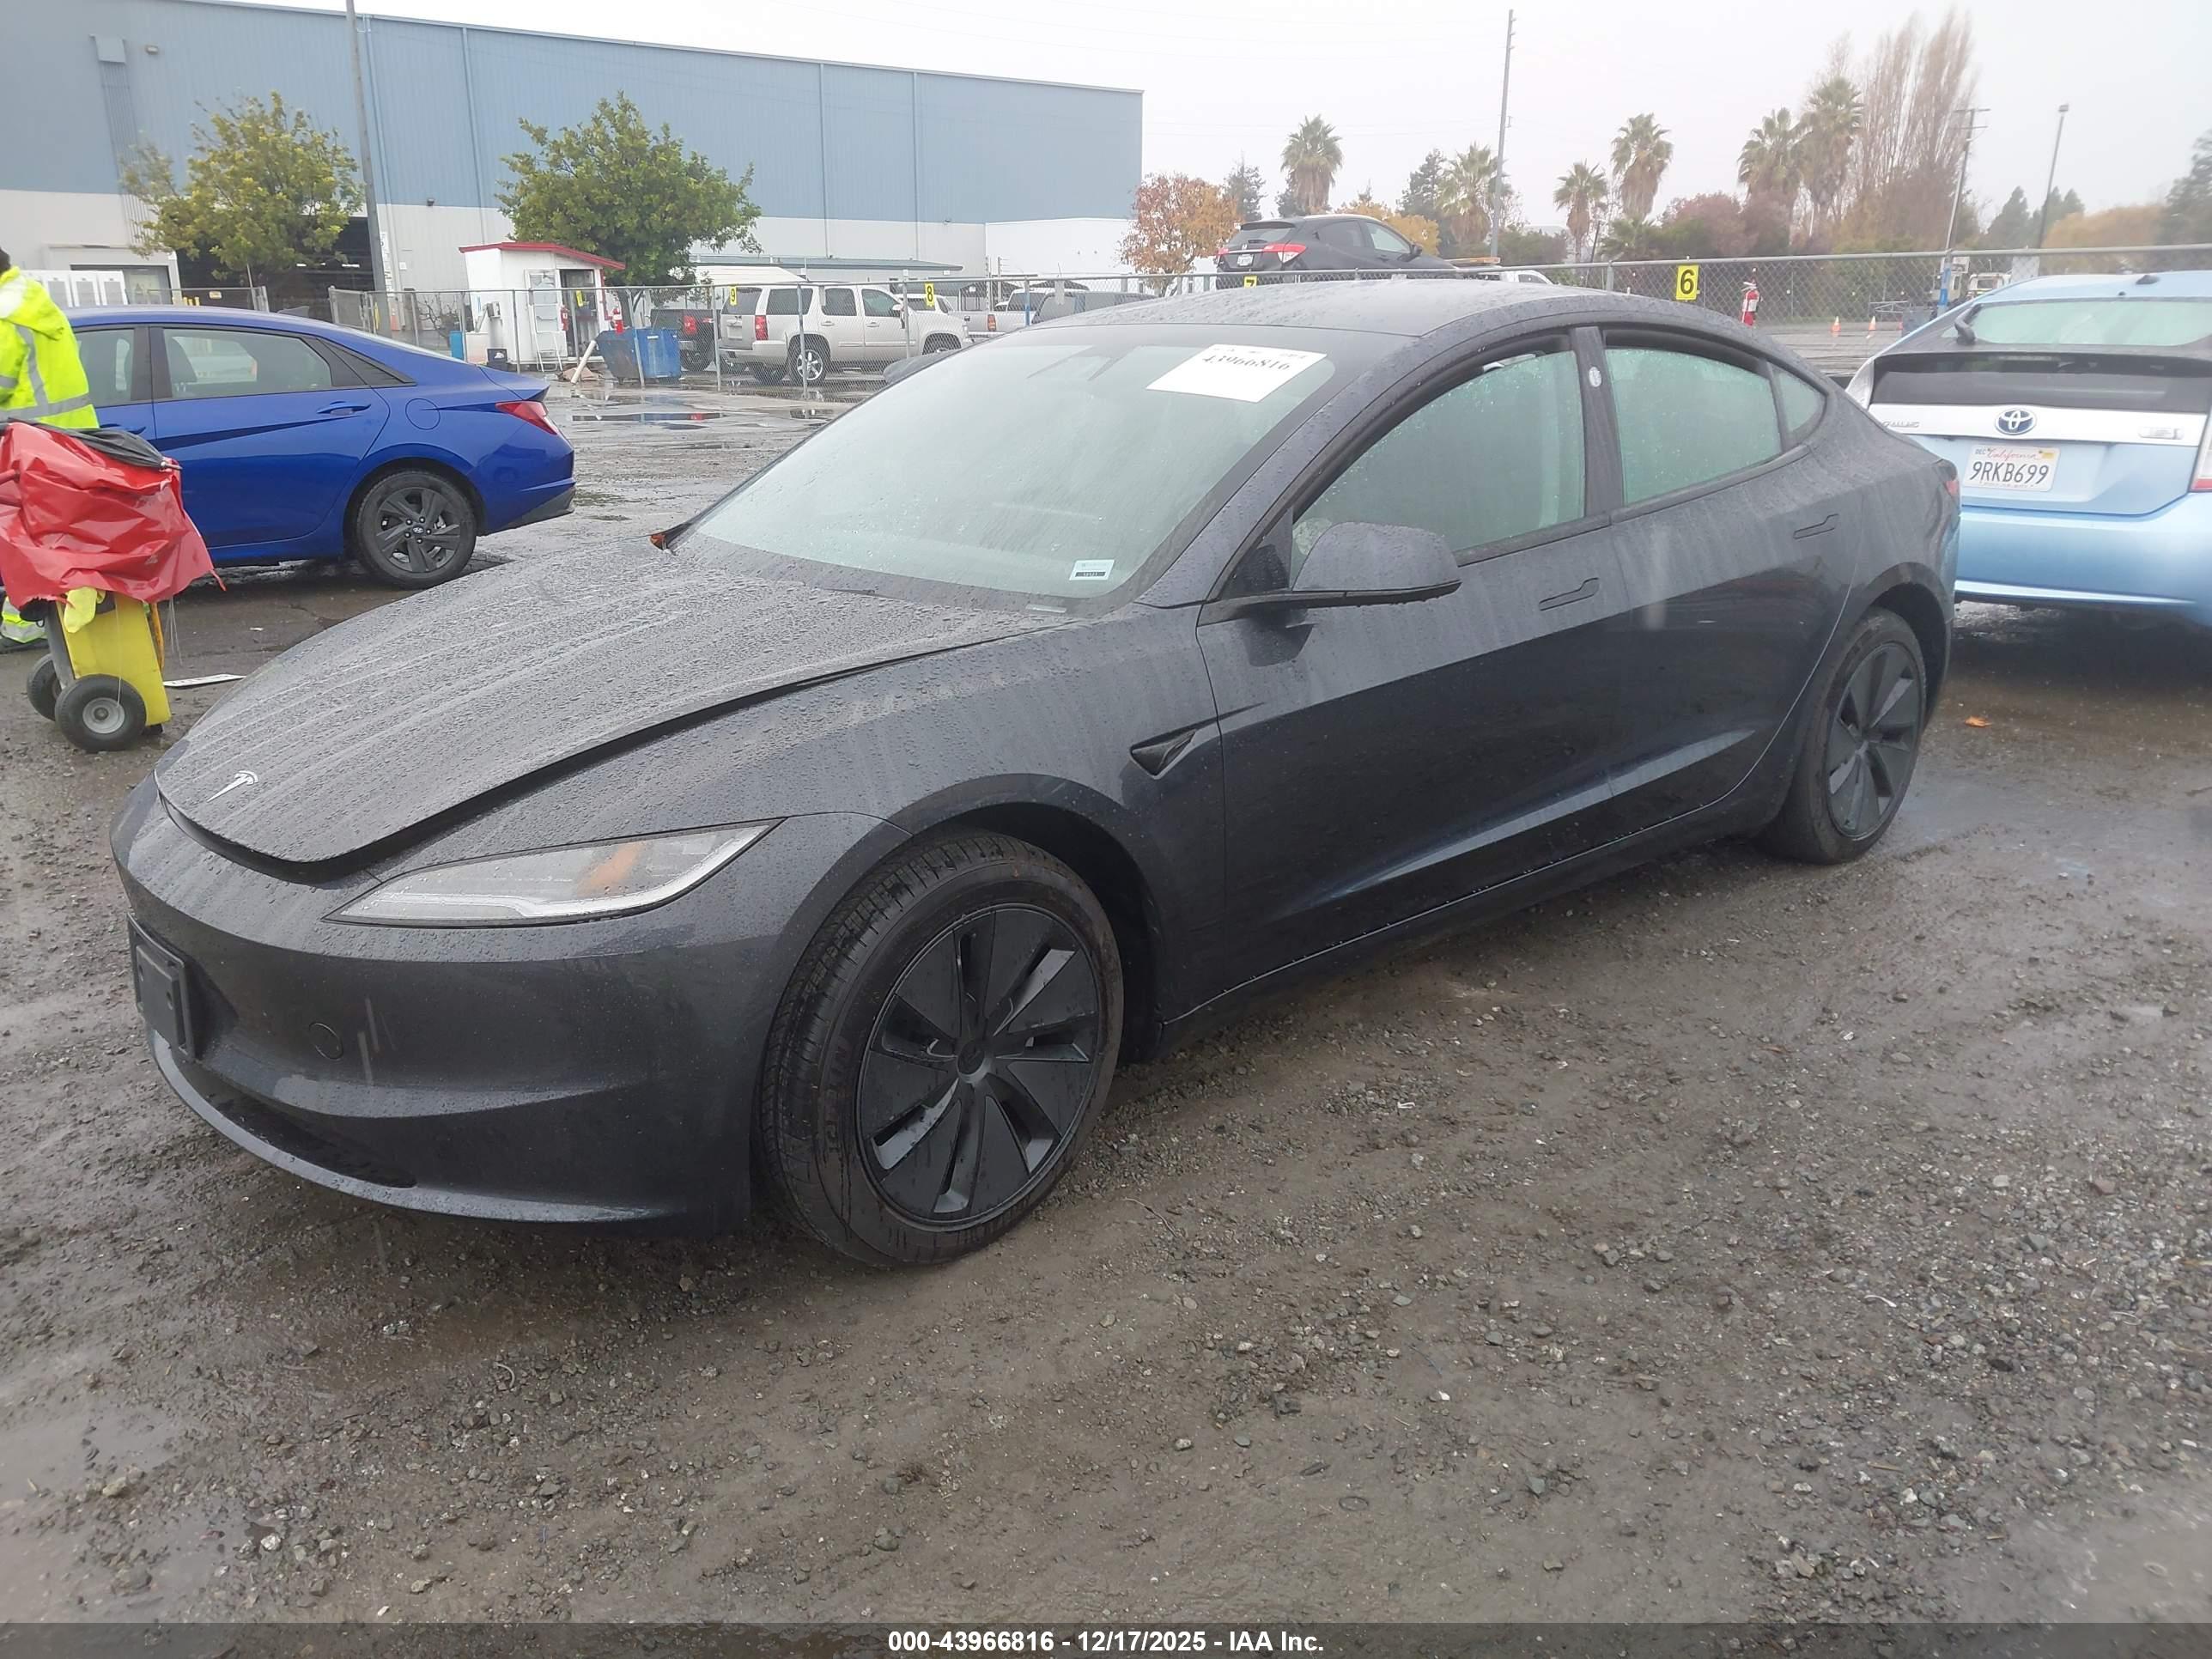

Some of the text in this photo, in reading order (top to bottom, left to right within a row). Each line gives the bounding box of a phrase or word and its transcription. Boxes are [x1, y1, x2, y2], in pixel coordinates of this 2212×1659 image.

[1680, 269, 1695, 295] 6
[731, 288, 736, 302] 9
[927, 285, 933, 302] 8
[1987, 447, 2039, 461] California
[1969, 461, 2050, 485] 9RKB699
